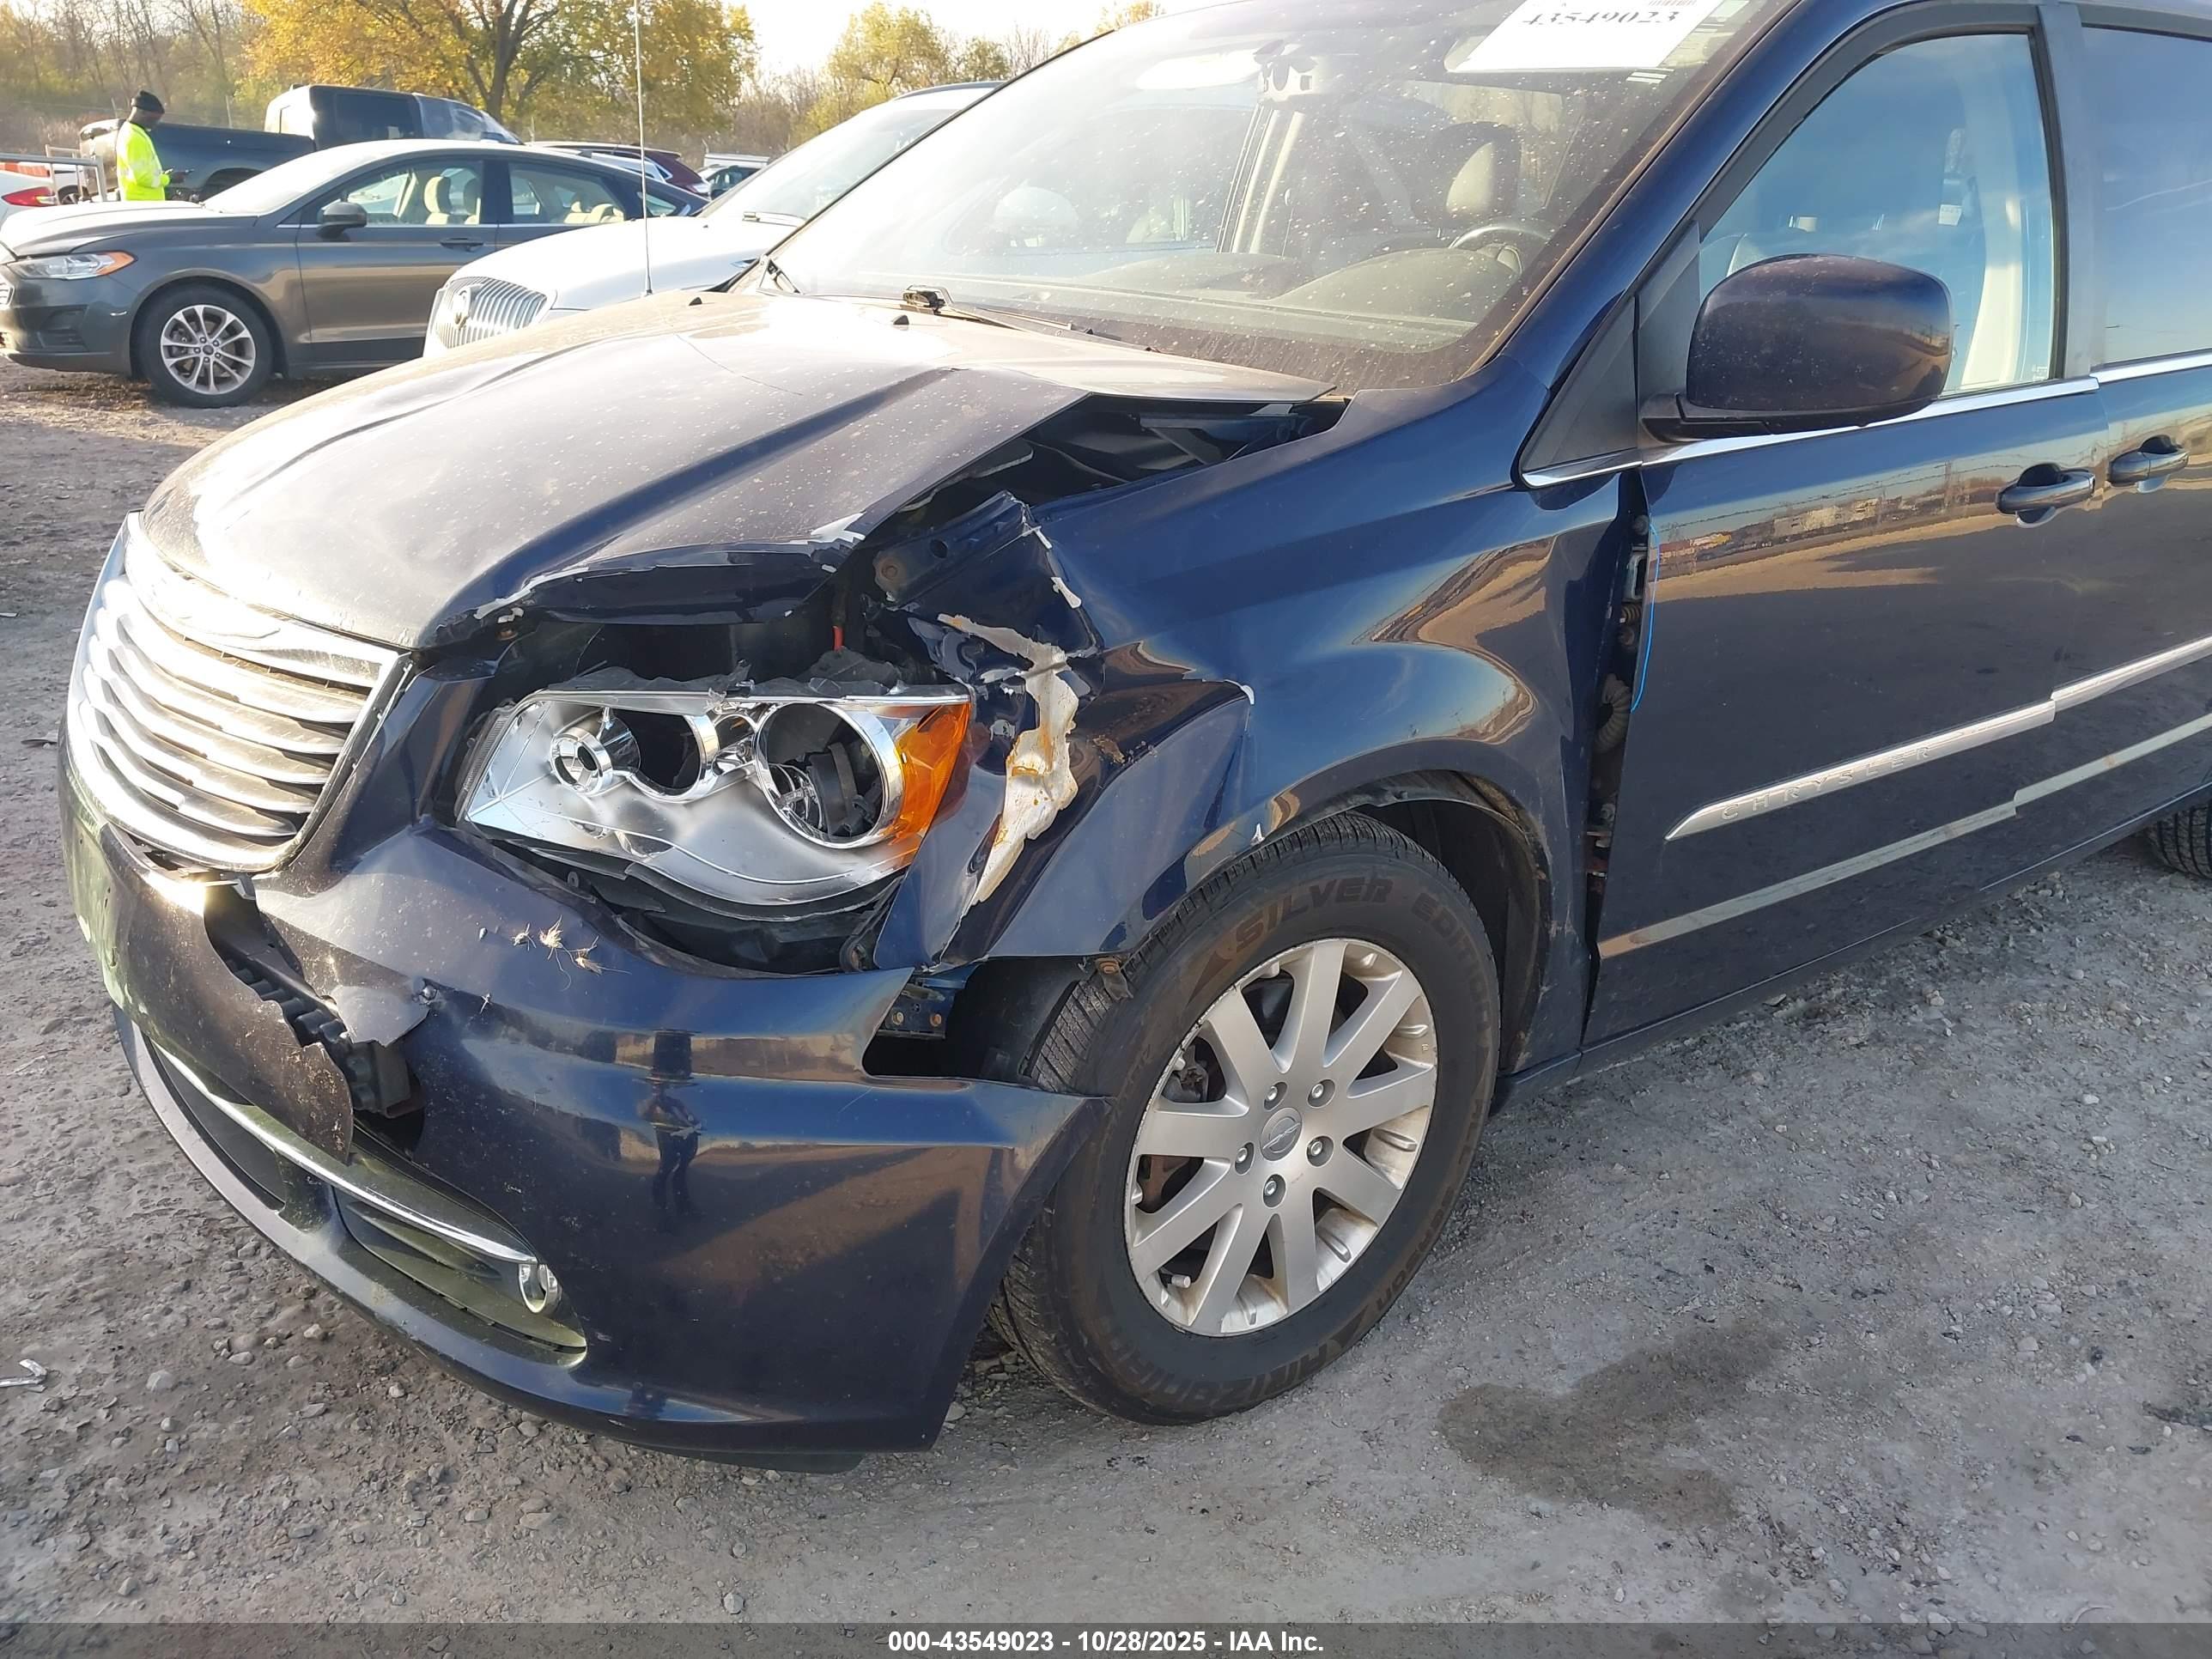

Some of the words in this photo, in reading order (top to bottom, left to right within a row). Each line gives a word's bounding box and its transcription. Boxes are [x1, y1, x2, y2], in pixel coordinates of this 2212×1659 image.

[1521, 9, 1680, 27] 43549023
[1719, 744, 1932, 822] CHRYSLER
[1235, 876, 1395, 953] SILVER
